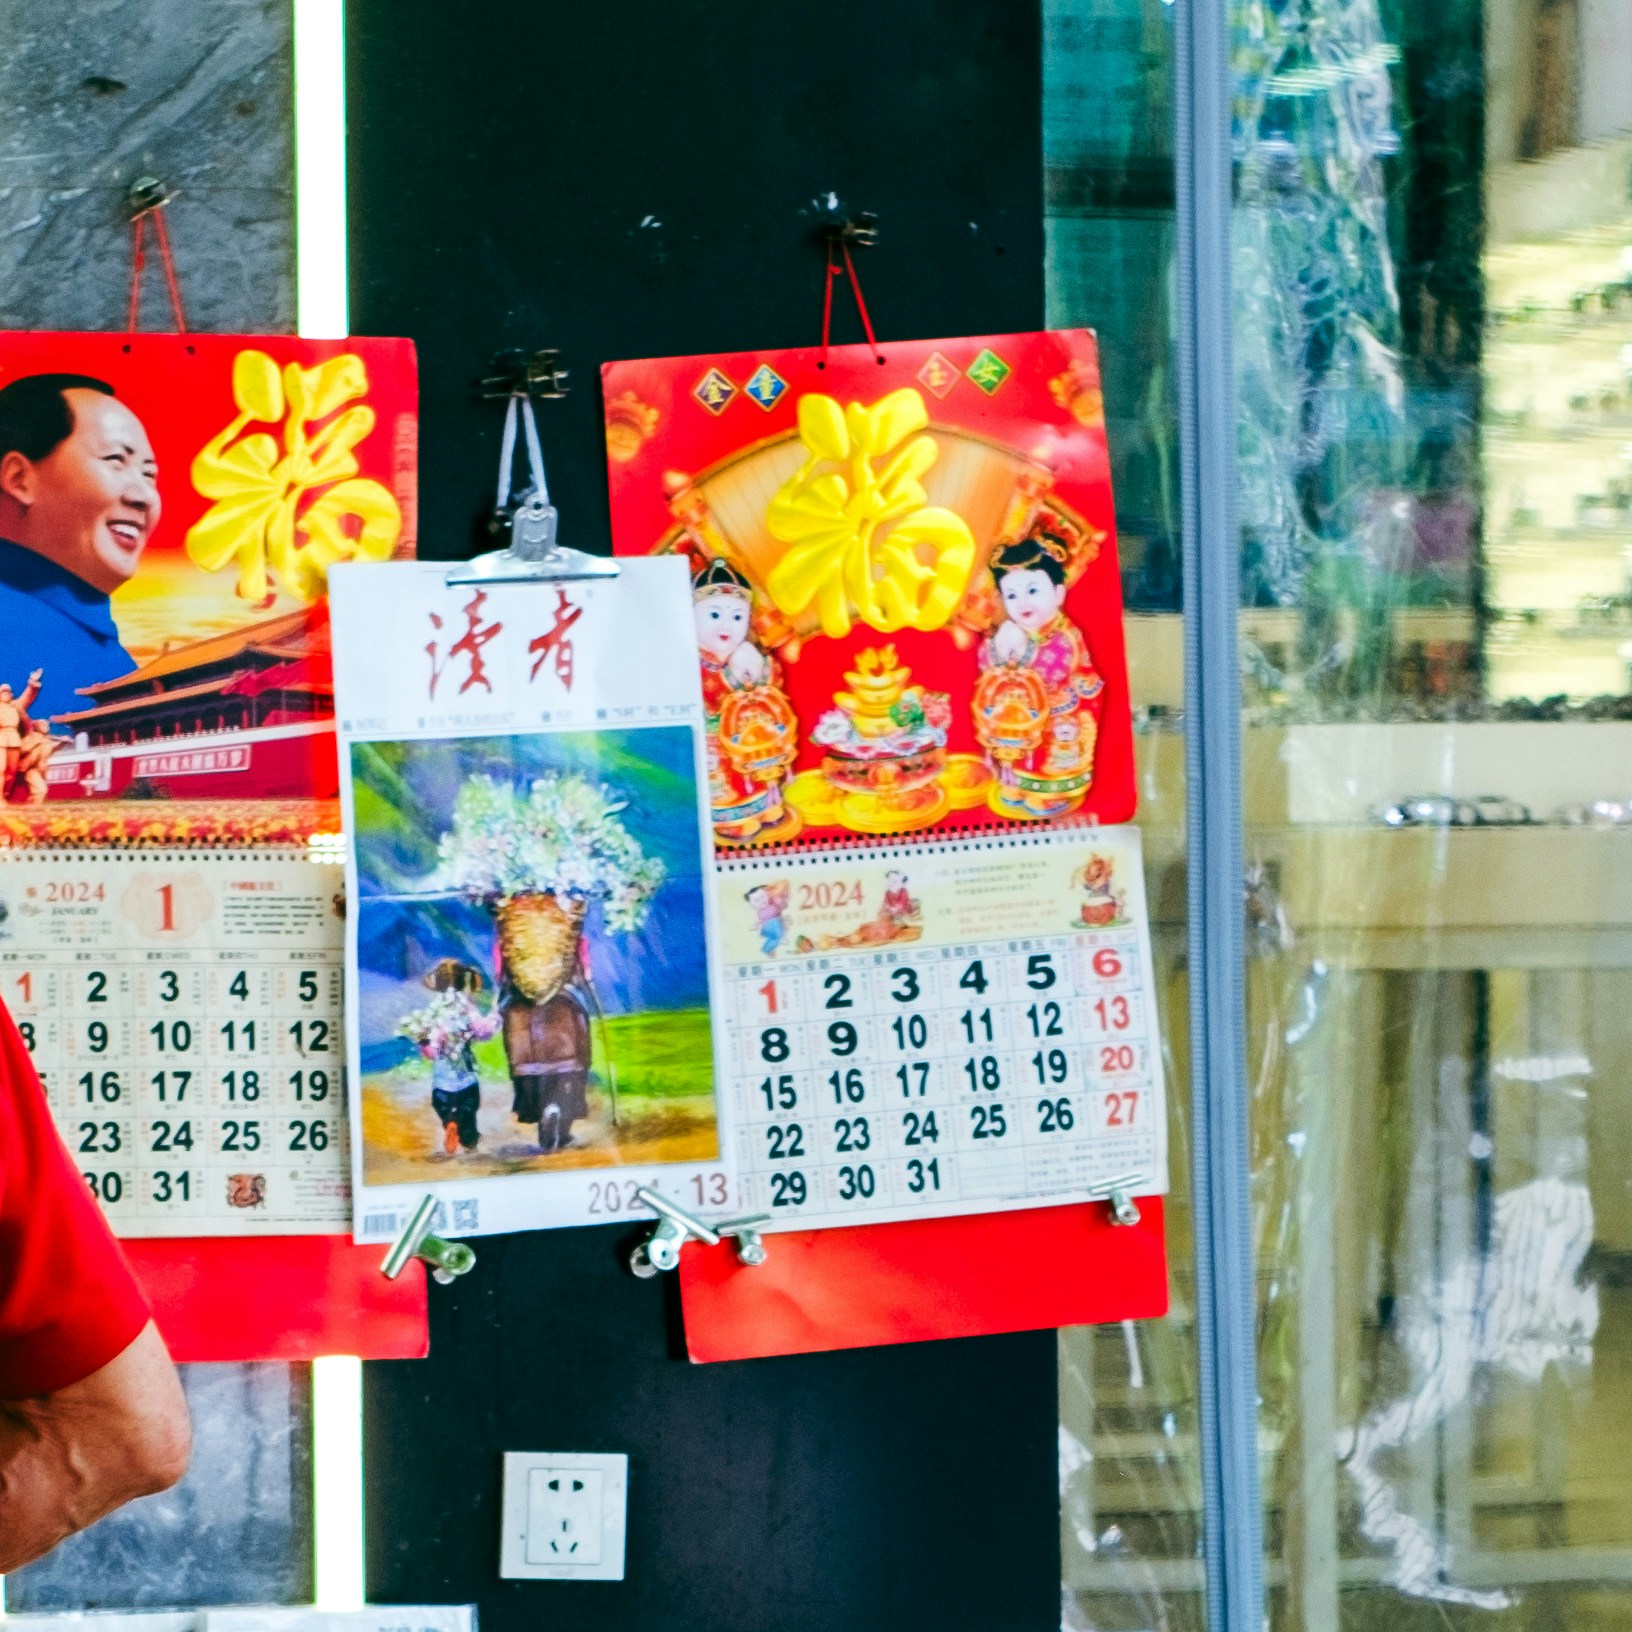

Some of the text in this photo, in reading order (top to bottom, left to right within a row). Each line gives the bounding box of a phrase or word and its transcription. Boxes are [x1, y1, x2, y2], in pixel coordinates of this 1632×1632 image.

[45, 881, 106, 903] 2024
[156, 882, 179, 933] 1
[797, 880, 865, 911] 2024
[17, 970, 318, 1003] 1 2 3 4 5
[761, 949, 1121, 1013] 1 2 3 4 5 6
[87, 1021, 108, 1053] 9
[150, 1020, 191, 1052] 10
[221, 1020, 255, 1051] 11
[289, 1020, 329, 1052] 12
[761, 996, 1130, 1063] 8 9 10 11 12 13
[79, 1070, 329, 1103] 16 17 18 19
[761, 1045, 1133, 1111] 15 16 17 18 19 20
[79, 1119, 329, 1153] 23 24 25 26
[767, 1092, 1139, 1159] 22 23 24 25 26 27
[152, 1170, 190, 1202] 31
[770, 1158, 940, 1207] 29 30 31
